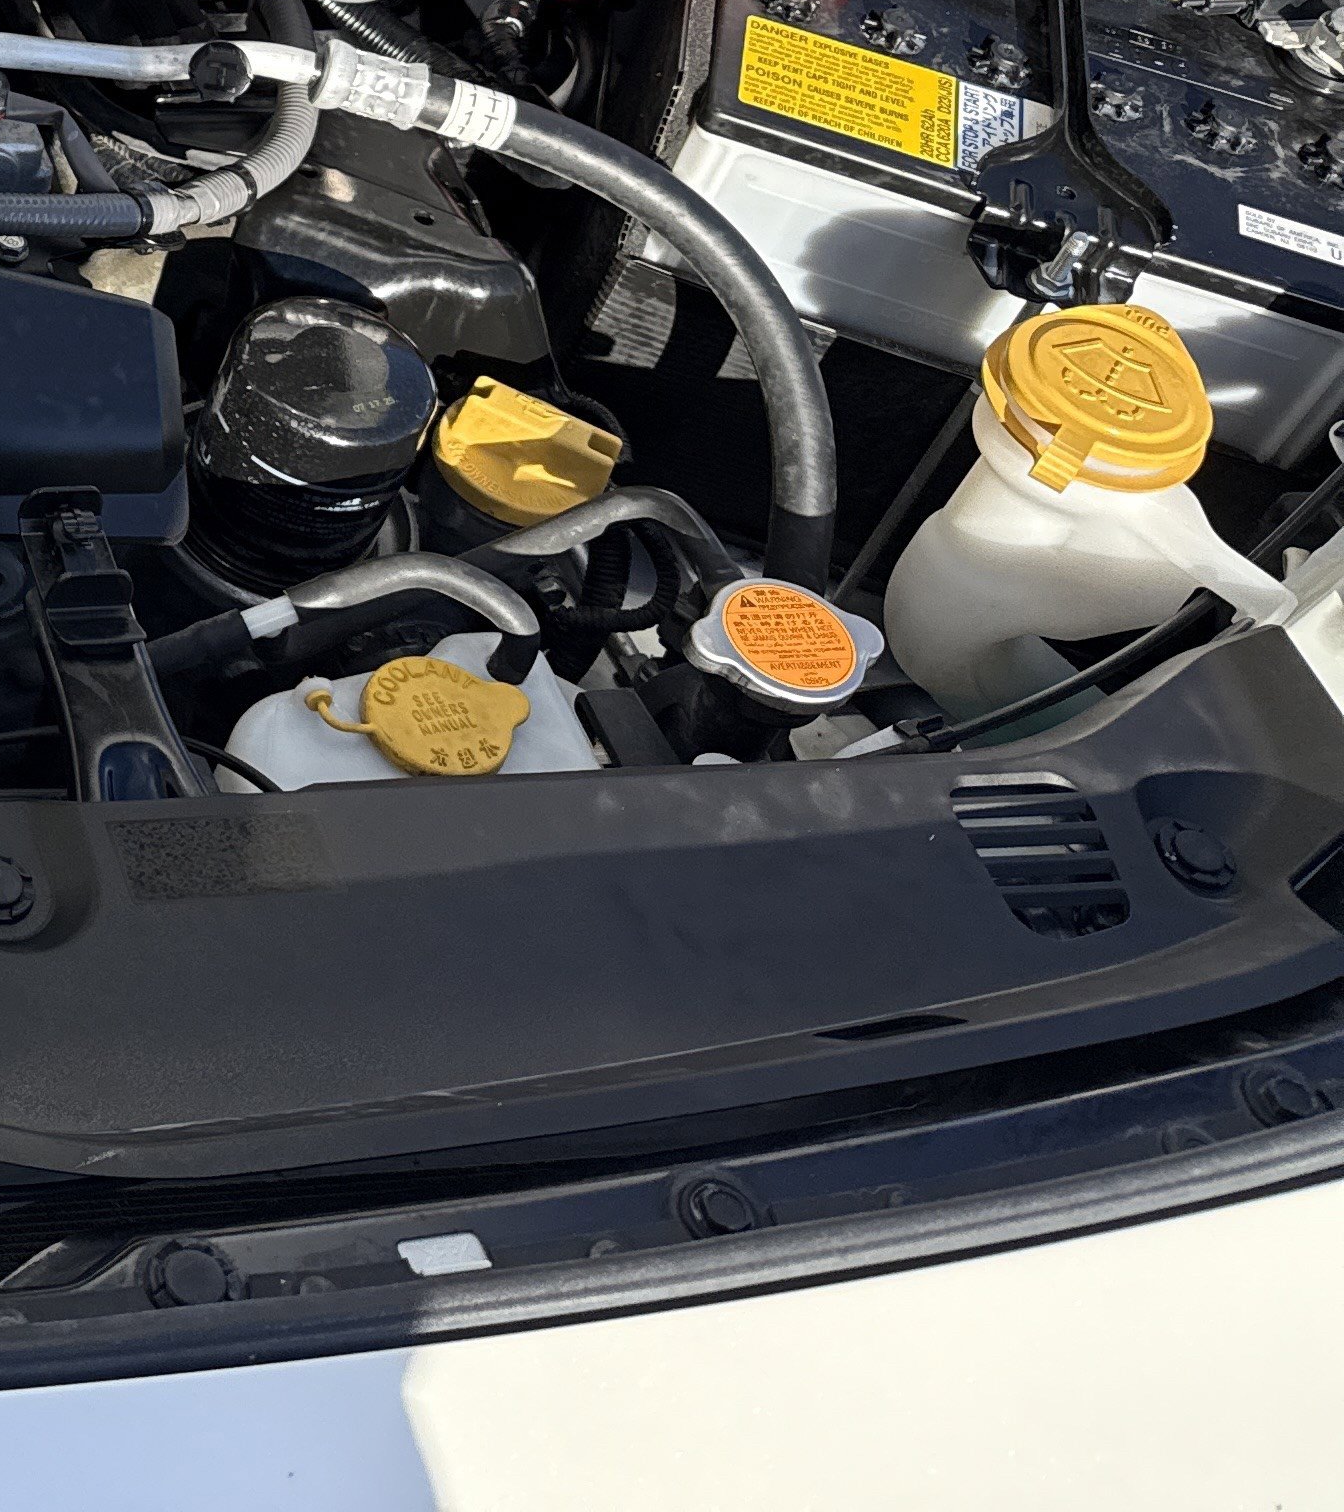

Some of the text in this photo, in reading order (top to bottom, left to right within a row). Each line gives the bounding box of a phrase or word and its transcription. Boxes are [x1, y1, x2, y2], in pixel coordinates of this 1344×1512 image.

[750, 19, 889, 69] DANGER EXPLOSIVE GASES
[757, 55, 779, 68] KEEP
[781, 63, 803, 75] VENT
[805, 70, 828, 84] CAPS
[831, 78, 856, 92] TIGHT
[859, 87, 877, 99] AND
[745, 63, 909, 121] POISON CAUSES SEVERE BURNS
[964, 85, 979, 115] START
[753, 95, 902, 147] KEEP OUT OF REACH OF CHILDREN
[962, 124, 978, 149] STOP
[936, 141, 950, 163] CCA
[962, 149, 978, 168] FOR
[754, 595, 802, 603] WARNING
[769, 660, 841, 670] AVERTISSEMENT
[373, 660, 480, 706] COOLANT
[412, 692, 445, 708] SEE
[412, 701, 469, 723] OWNERS
[418, 715, 477, 736] MANUAL
